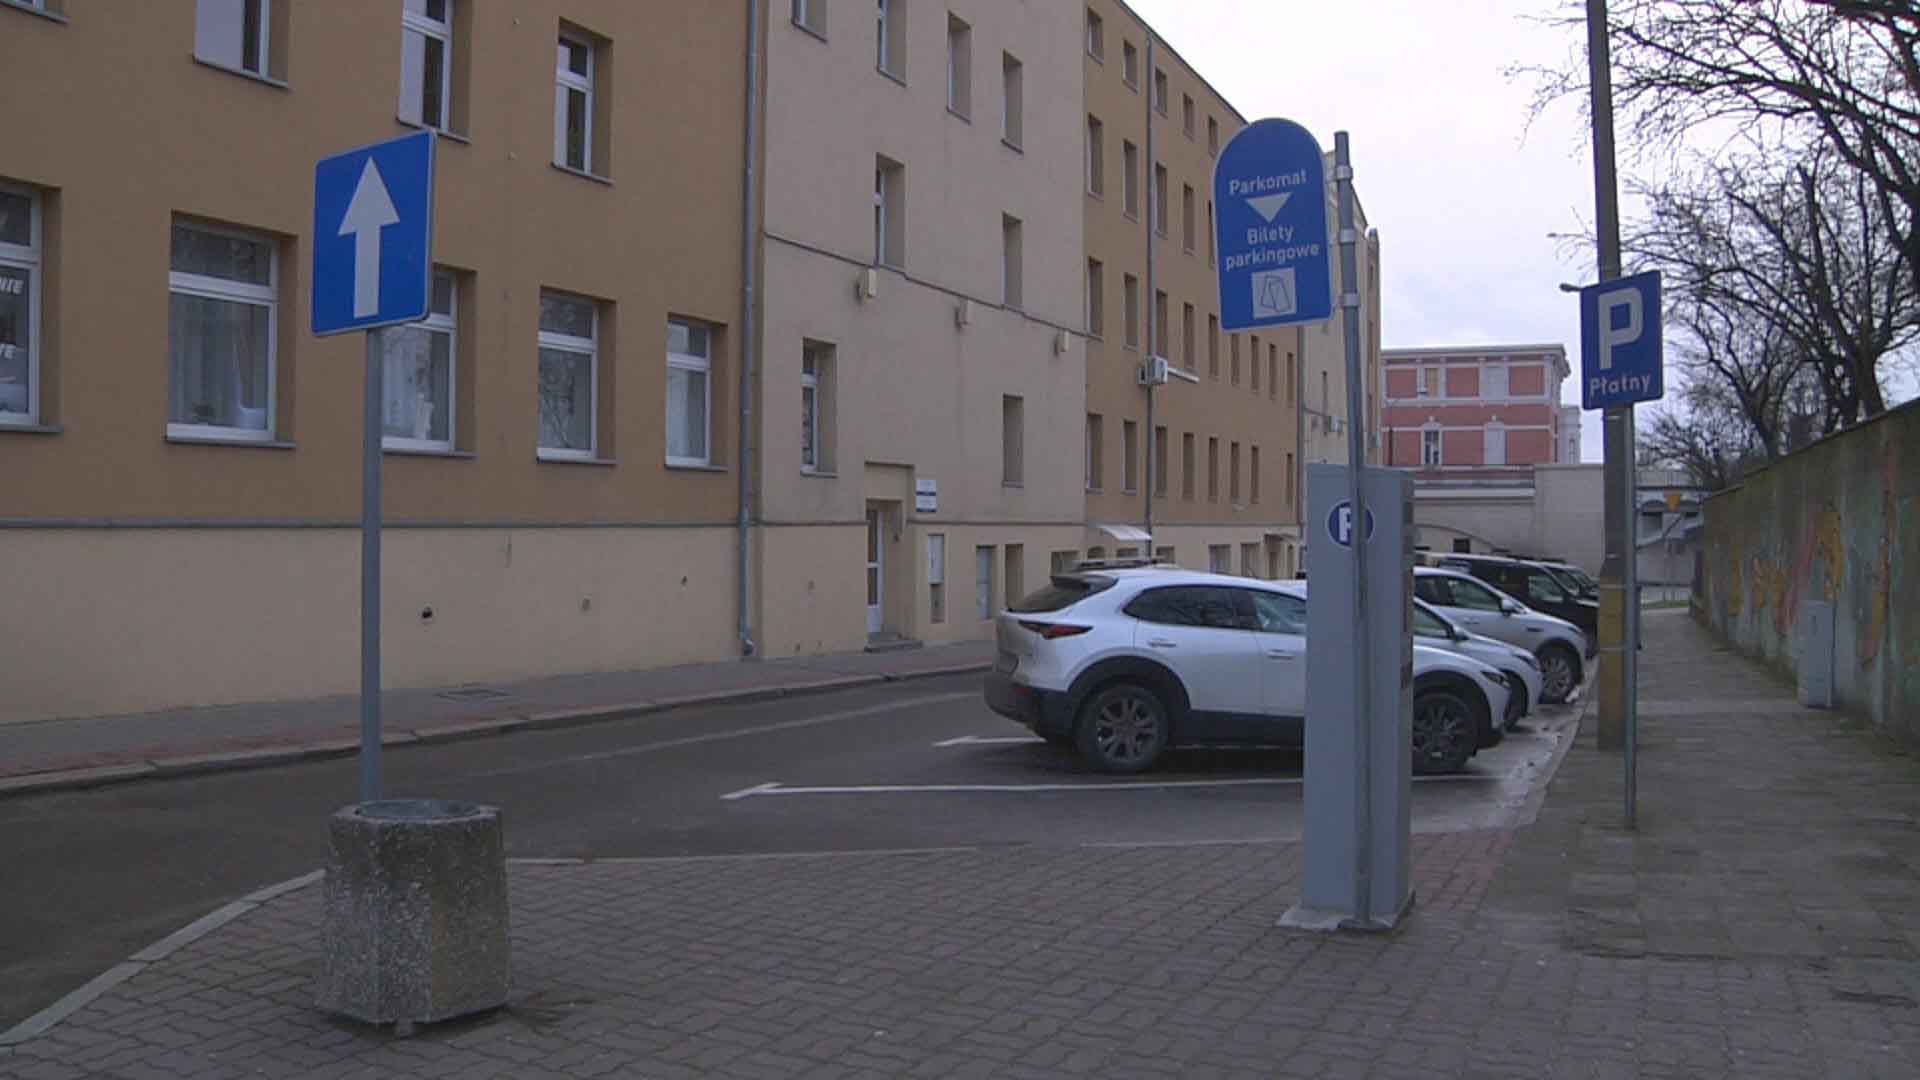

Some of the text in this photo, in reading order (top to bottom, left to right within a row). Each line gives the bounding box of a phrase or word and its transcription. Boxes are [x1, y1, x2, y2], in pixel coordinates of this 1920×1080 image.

[1229, 169, 1306, 194] Parkomat
[1247, 225, 1294, 245] Bilety
[1226, 244, 1319, 271] parkingowe
[1598, 287, 1643, 369] P
[1590, 373, 1651, 398] Płatny
